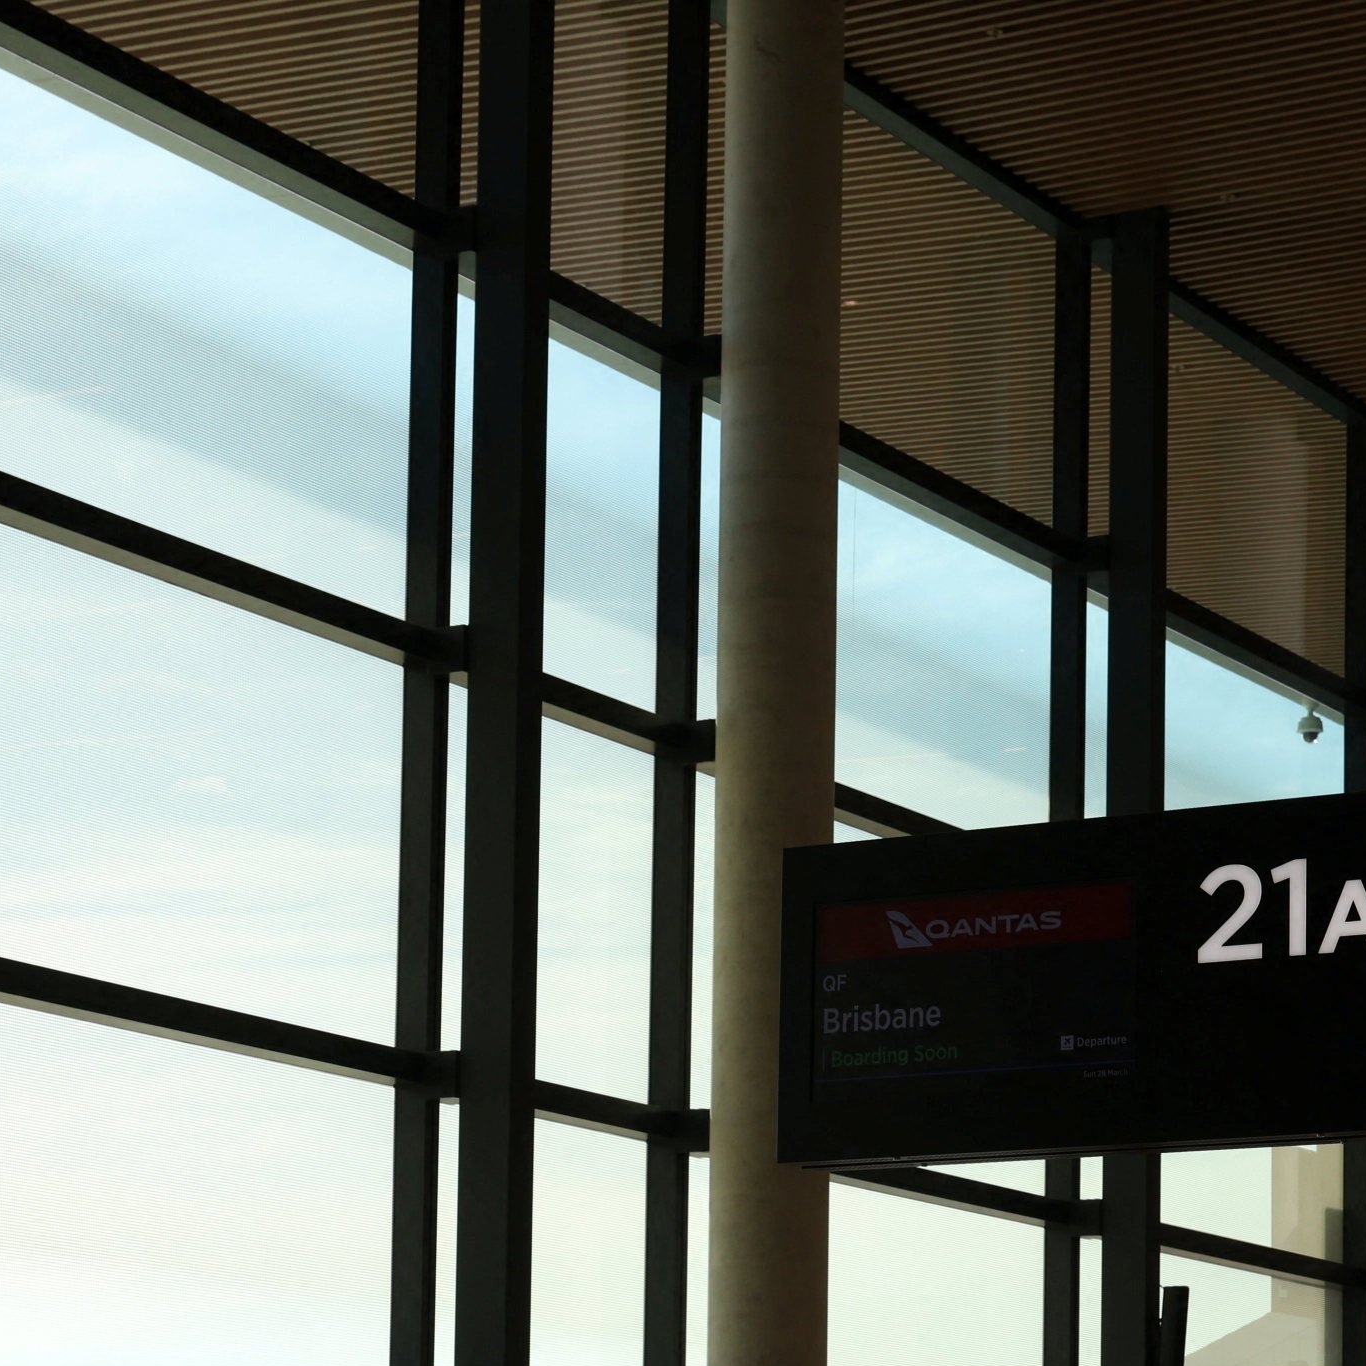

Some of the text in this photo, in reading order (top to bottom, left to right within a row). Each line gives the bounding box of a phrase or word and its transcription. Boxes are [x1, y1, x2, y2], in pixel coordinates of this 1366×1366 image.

[925, 911, 1062, 939] QANTAS
[822, 974, 848, 992] QF
[822, 1003, 942, 1035] Brisbane
[1076, 1035, 1128, 1049] Departure
[831, 1045, 958, 1069] Boarding Soon
